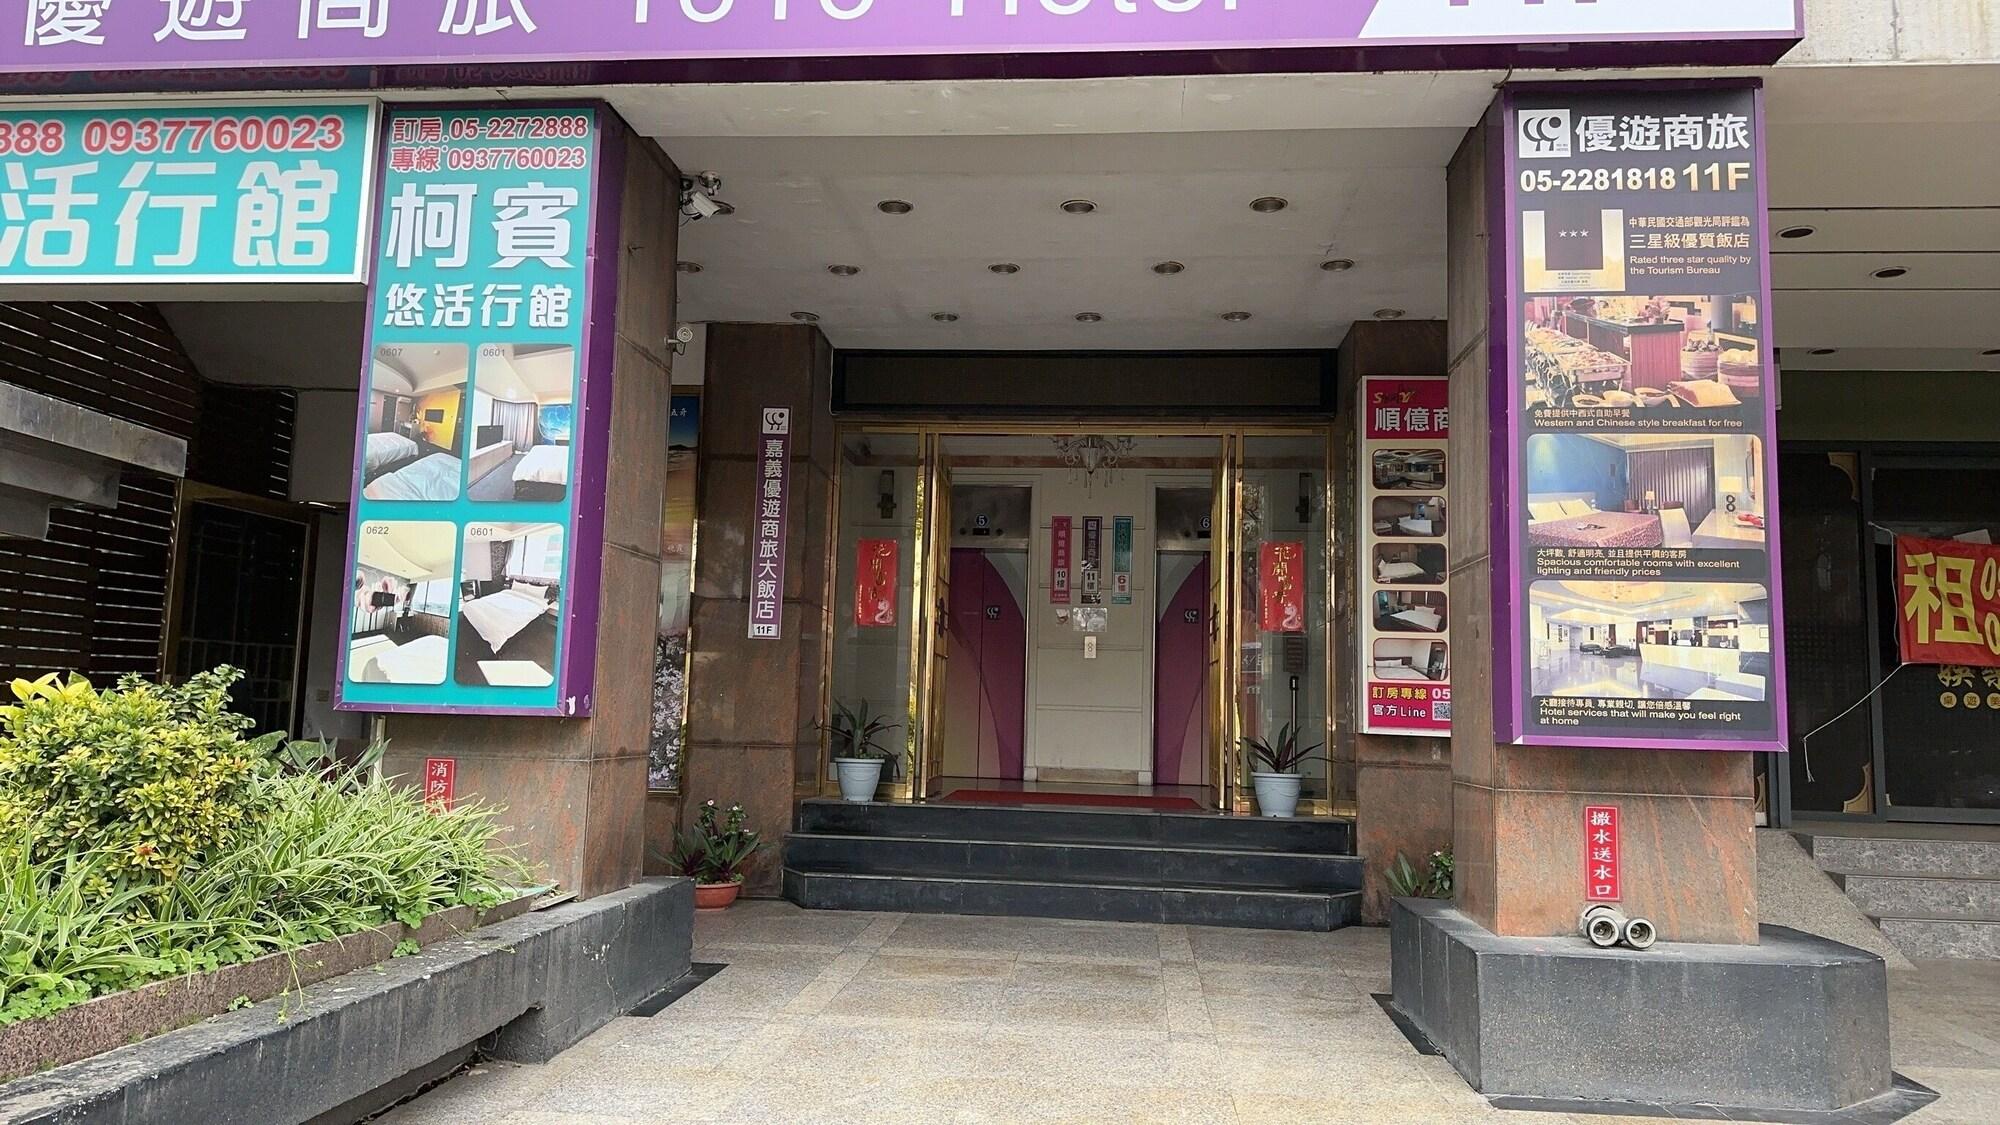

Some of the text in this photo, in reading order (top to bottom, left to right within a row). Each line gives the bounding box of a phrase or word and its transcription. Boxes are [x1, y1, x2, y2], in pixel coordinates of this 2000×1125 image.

[82, 115, 345, 154] 0937760023
[449, 115, 589, 141] 05-2272888
[1575, 112, 1750, 153] 優遊商旅
[390, 146, 586, 172] 專線 0937760023
[1519, 162, 1750, 193] 05-2281818 11F
[0, 159, 339, 267] 活行館
[385, 181, 579, 268] 柯賓
[1629, 232, 1750, 250] 三星級優質飯店
[1630, 255, 1751, 266] Rated three star quality by
[1630, 266, 1721, 275] the Tourism Bureau
[383, 283, 572, 328] 悠活行館
[482, 348, 505, 357] 0601
[1374, 407, 1448, 432] 順億商
[1534, 418, 1743, 429] Western and Chinese style breakfast for free
[756, 439, 783, 619] 嘉義優遊商旅大飯店
[978, 515, 985, 526] 5
[366, 526, 389, 535] 0622
[470, 527, 494, 536] 0601
[1537, 557, 1581, 568] Spacious
[1584, 558, 1641, 567] comfortable
[1675, 559, 1695, 568] with
[1697, 559, 1740, 569] excellent
[1537, 566, 1661, 578] lighting and friendly prices
[1903, 551, 1985, 646] 租
[756, 625, 773, 635] 11F
[1372, 686, 1450, 700] 訂房專線 05
[1540, 706, 1741, 723] Hotel services that will make you feel right
[1540, 716, 1579, 726] at home
[1590, 811, 1614, 896] 撒水送水口
